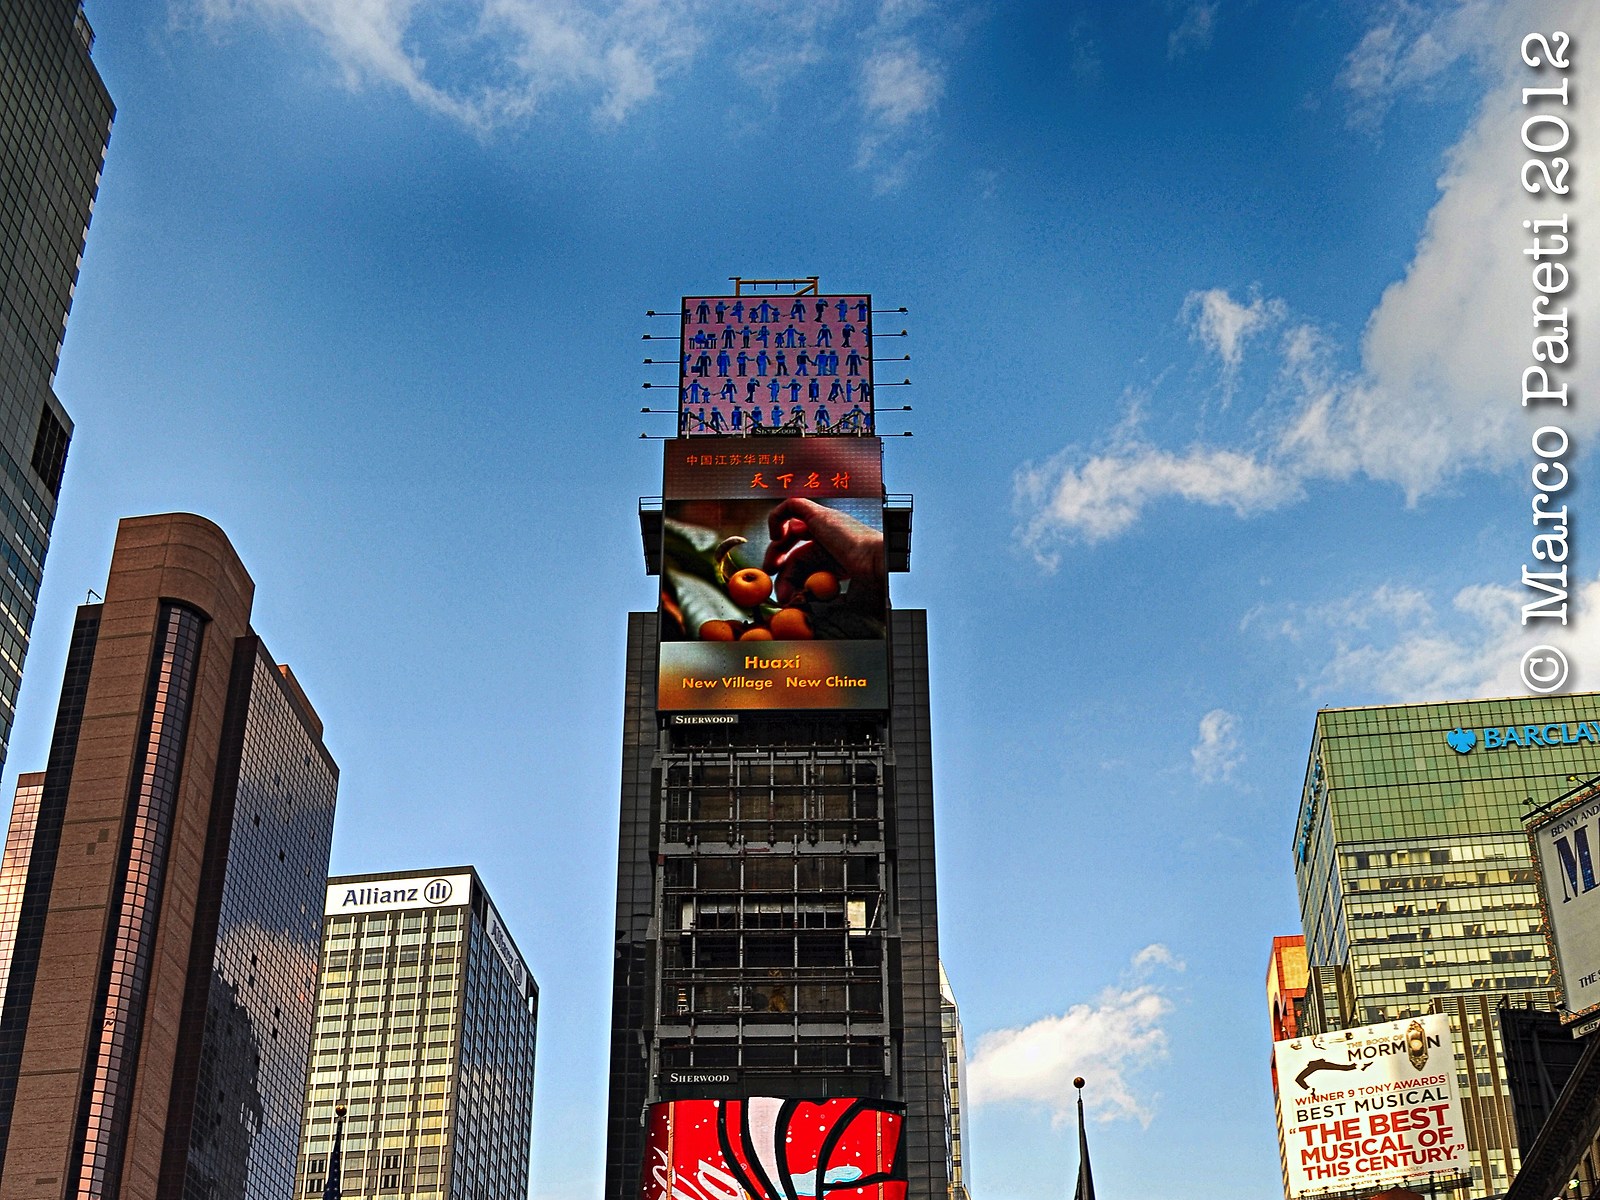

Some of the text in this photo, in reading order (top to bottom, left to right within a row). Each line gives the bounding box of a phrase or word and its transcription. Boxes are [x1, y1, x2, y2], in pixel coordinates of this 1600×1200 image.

[744, 654, 801, 670] Huaxi
[682, 675, 867, 691] New Village New China
[1550, 816, 1578, 837] BENNY
[1553, 824, 1600, 904] M
[342, 888, 418, 907] Allianz
[1579, 971, 1597, 989] THE
[1295, 1074, 1446, 1106] WINNER 9 TONY AWARDS
[1296, 1087, 1449, 1123] BEST MUSICAL
[1369, 1103, 1450, 1136] BEST
[1300, 1126, 1454, 1166] MUSICAL OF
[1302, 1162, 1351, 1181] THIS
